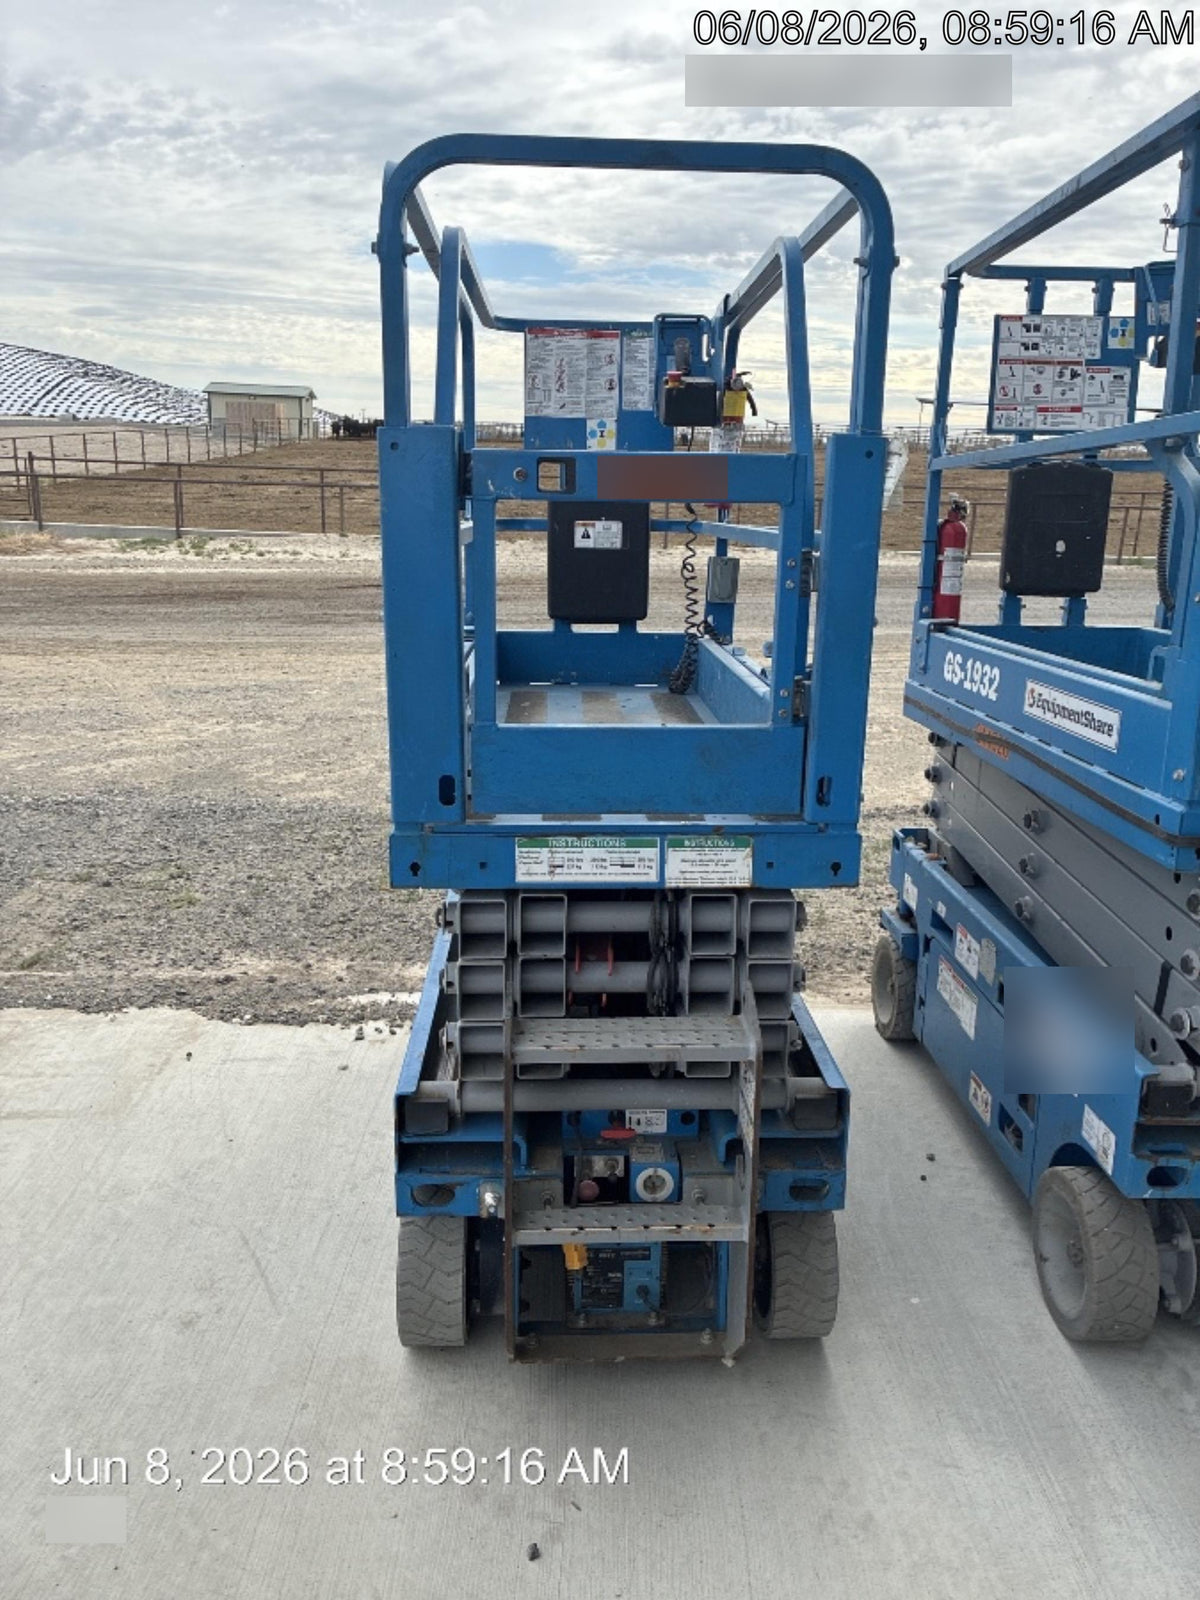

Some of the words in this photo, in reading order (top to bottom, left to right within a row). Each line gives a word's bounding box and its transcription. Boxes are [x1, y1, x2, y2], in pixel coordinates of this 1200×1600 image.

[943, 650, 1000, 702] GS-1932
[1036, 692, 1114, 738] EquipmentShare
[548, 839, 627, 847] INSTRUCTIONS
